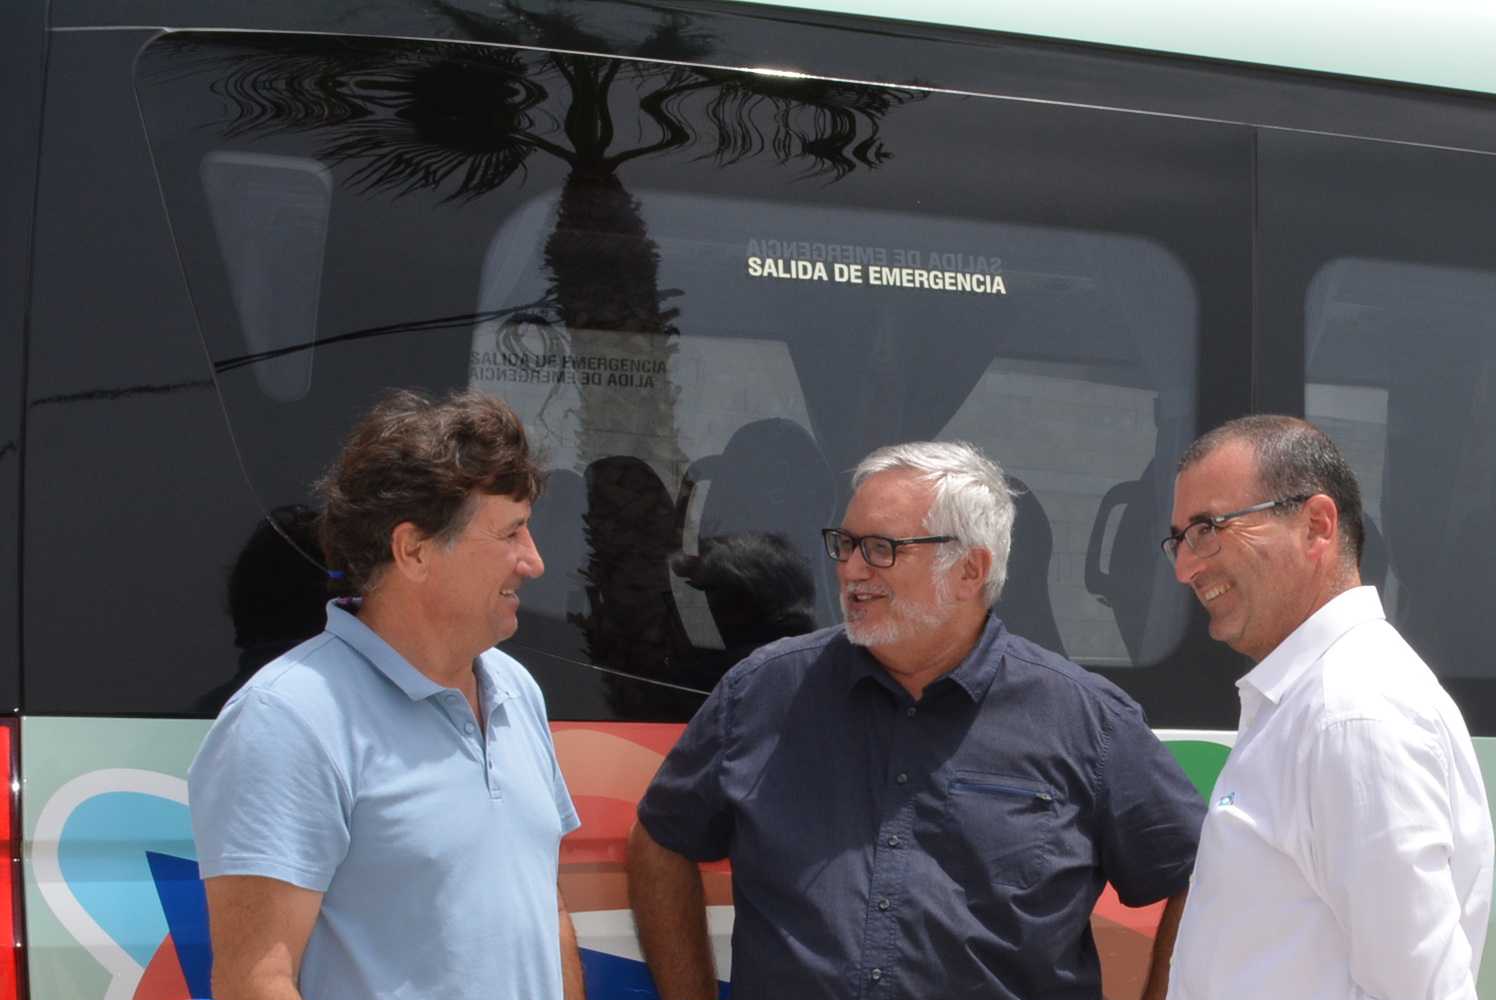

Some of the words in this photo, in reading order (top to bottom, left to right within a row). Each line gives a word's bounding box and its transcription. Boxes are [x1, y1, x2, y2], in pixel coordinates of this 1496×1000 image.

[748, 256, 828, 281] SALIDA
[834, 263, 862, 284] DE
[869, 265, 1007, 295] EMERGENCIA
[471, 352, 530, 369] SALIDA
[562, 355, 667, 375] EMERGENCIA
